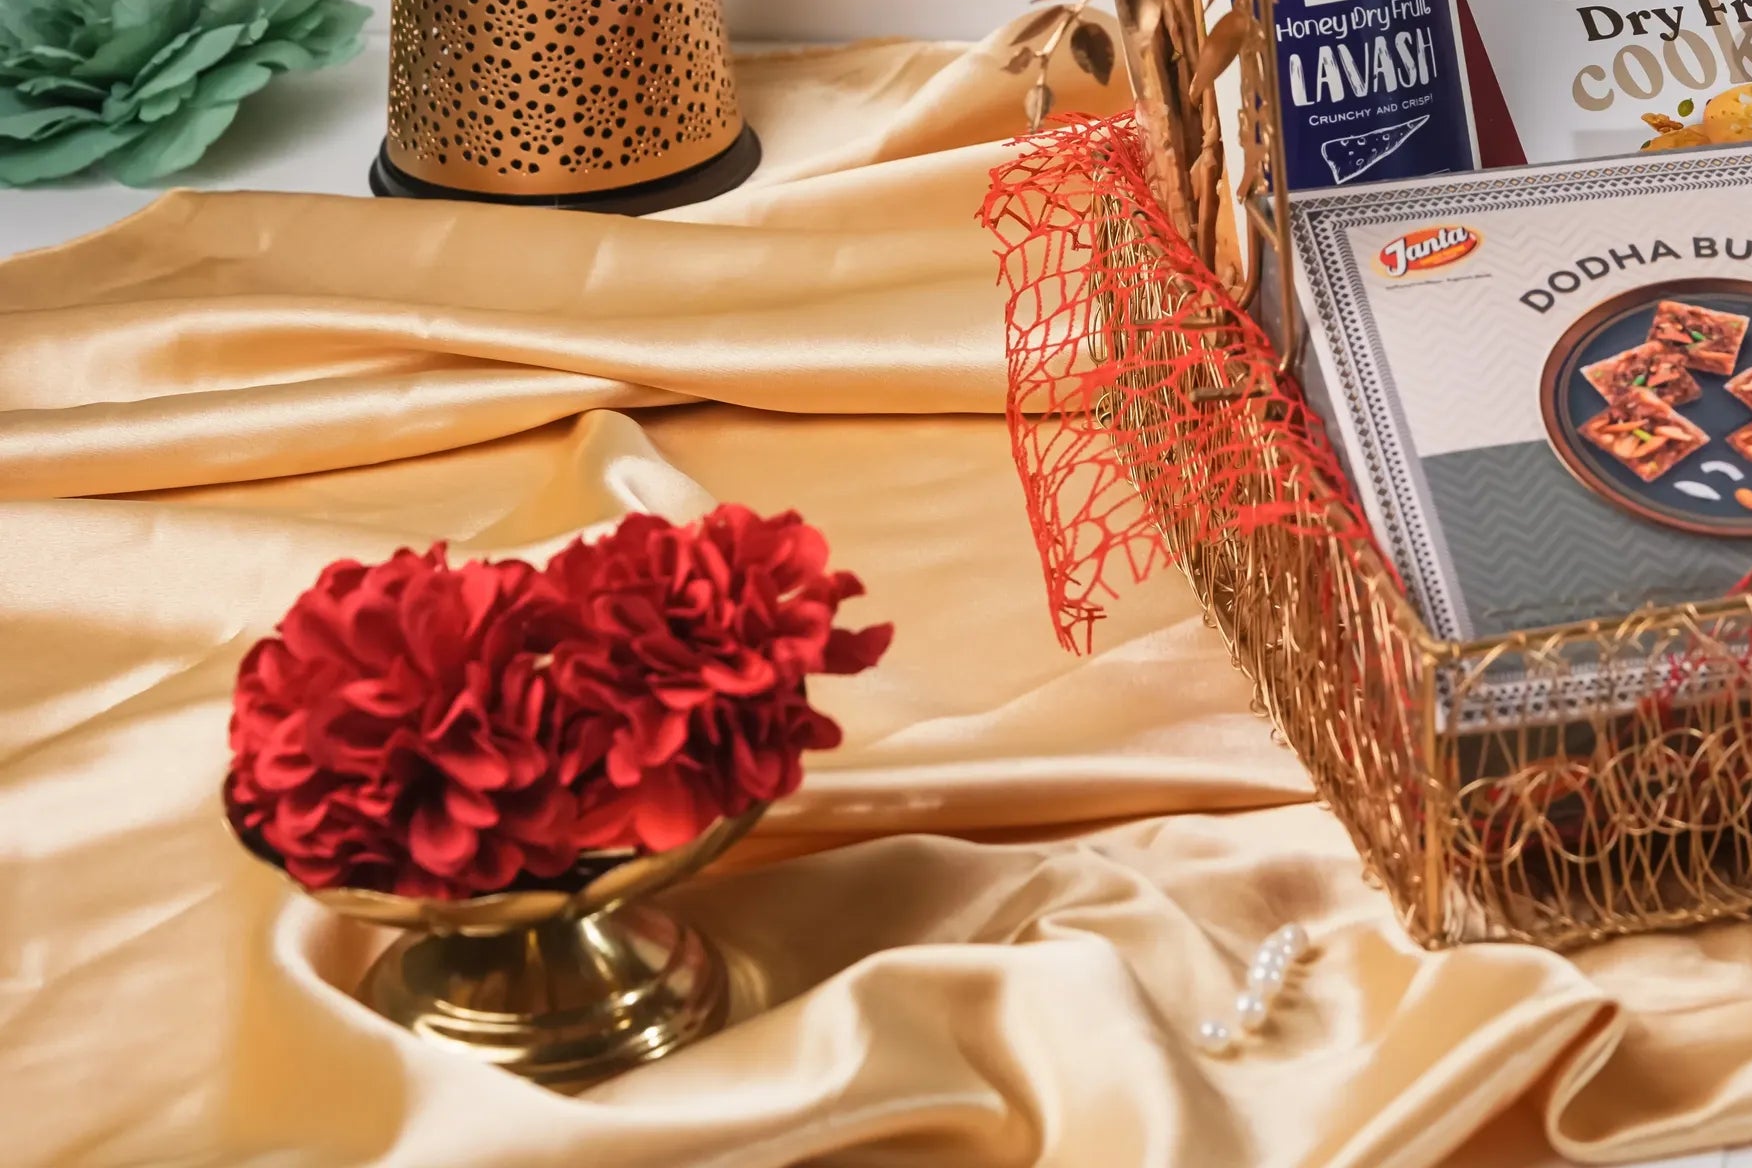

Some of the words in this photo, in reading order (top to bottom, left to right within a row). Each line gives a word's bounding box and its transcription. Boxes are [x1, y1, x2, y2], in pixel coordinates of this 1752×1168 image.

[1276, 13, 1348, 42] Honey
[1351, 6, 1390, 31] Dry
[1576, 5, 1684, 42] Dry
[1289, 26, 1438, 107] LAVASH
[1308, 108, 1372, 126] CRUNCHY
[1376, 103, 1399, 116] AND
[1401, 92, 1434, 111] CRISP!
[1385, 226, 1470, 278] Janta
[1519, 239, 1683, 315] DODHA
